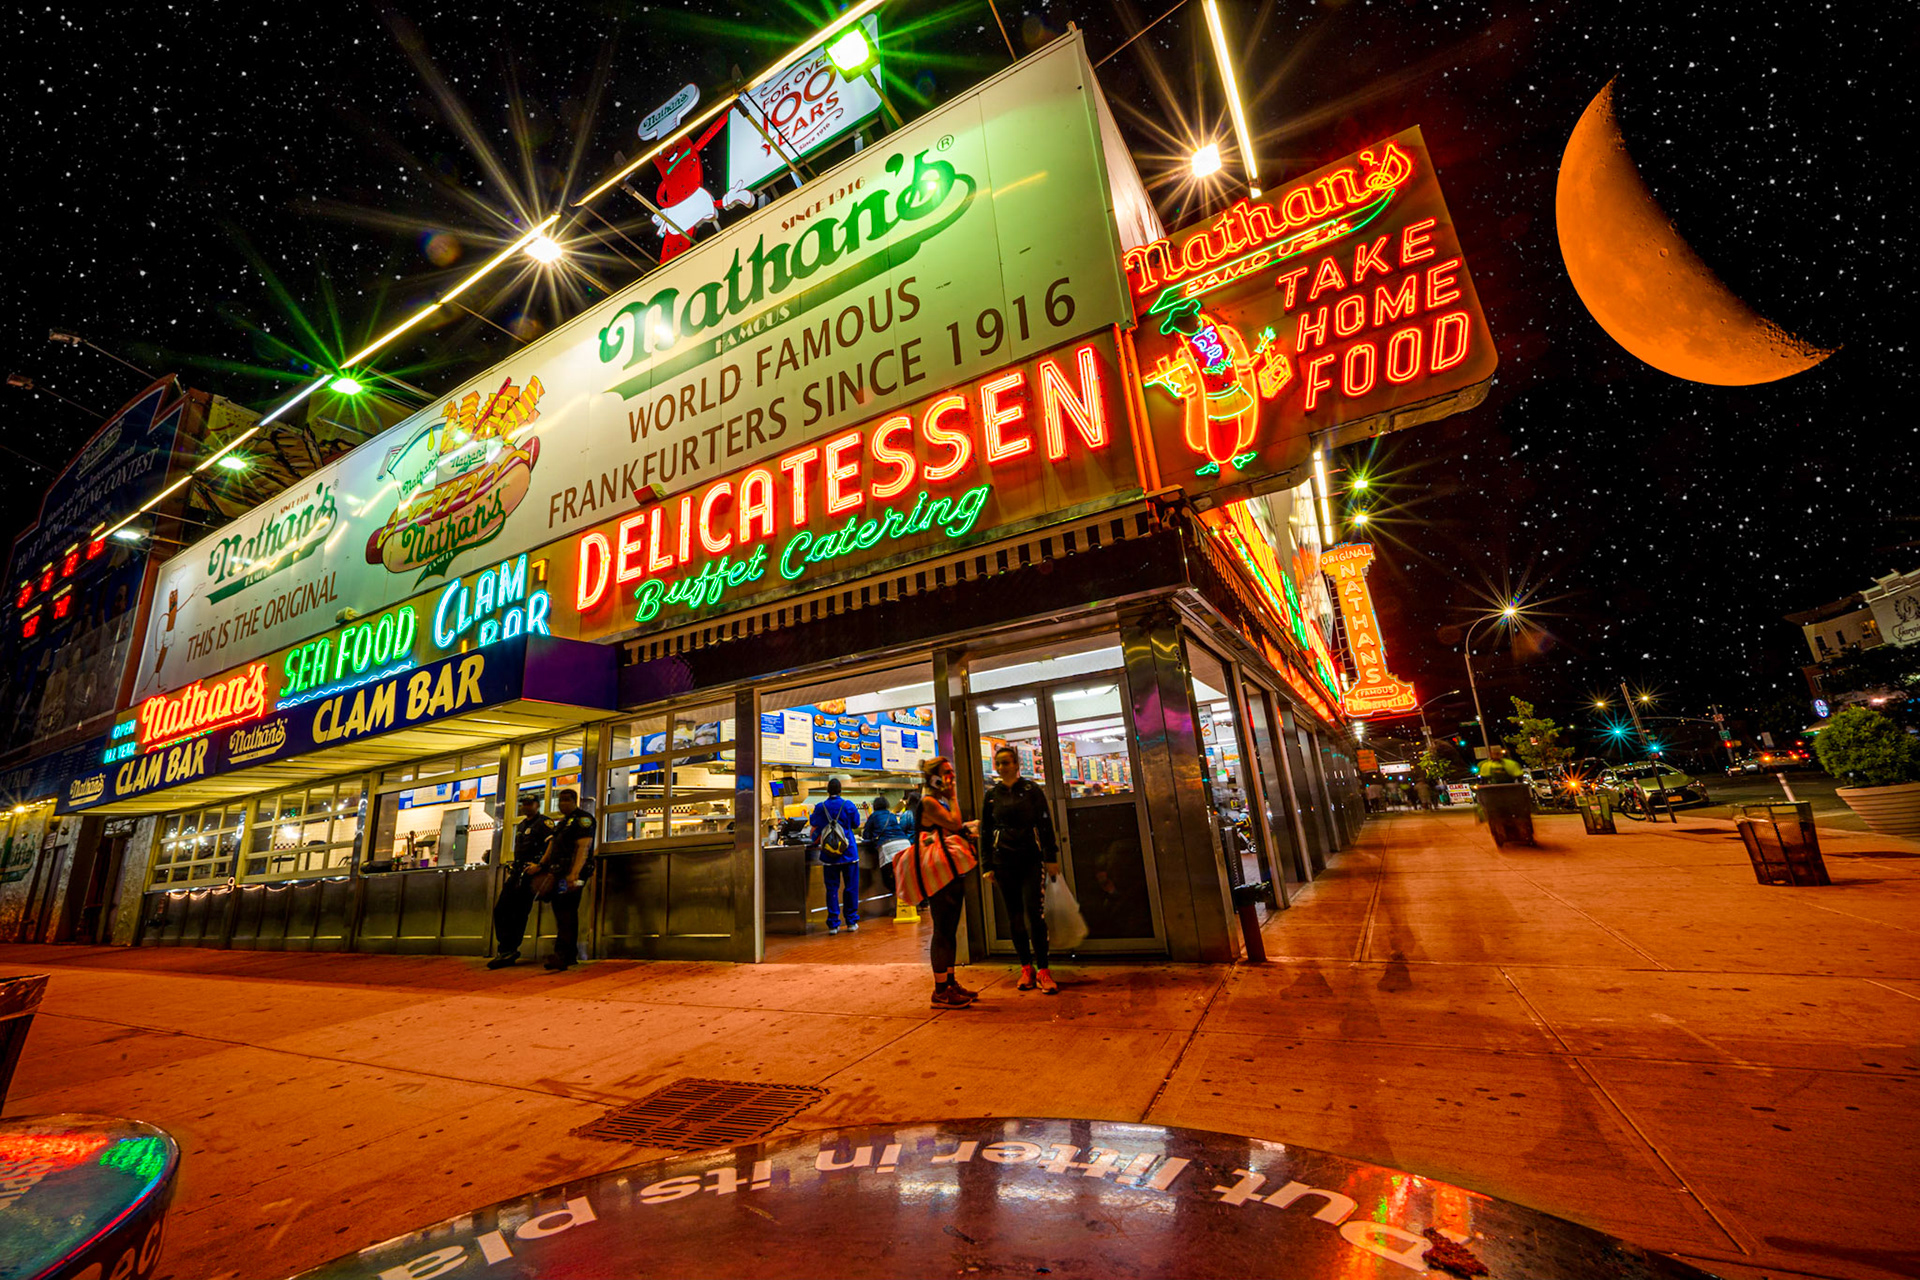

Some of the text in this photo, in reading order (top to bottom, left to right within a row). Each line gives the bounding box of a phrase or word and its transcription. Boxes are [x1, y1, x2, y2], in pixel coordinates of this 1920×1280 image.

[642, 92, 690, 129] Nathan's
[761, 90, 839, 157] YEARS
[762, 82, 791, 111] FOR
[763, 64, 837, 139] 100
[816, 122, 831, 138] 1916
[781, 175, 868, 232] SINCE 1916
[1124, 143, 1413, 294] Nathan's
[598, 148, 957, 371] Nathan's
[1186, 231, 1319, 297] FAMOUS
[1277, 217, 1437, 309] TAKE
[714, 303, 792, 355] FAMOUS
[1296, 258, 1463, 353] HOME
[628, 276, 922, 443] WORLD FAMOUS
[1304, 311, 1471, 412] FOOD
[548, 277, 1077, 529] FRANKFURTERS SINCE 1916
[103, 447, 160, 496] CONTEST
[575, 343, 1109, 613] DELICATESSEN
[207, 481, 337, 585] Nathan's
[401, 487, 503, 565] Nathan's
[633, 483, 992, 623] Buffet Catering
[1321, 546, 1371, 565] ORIGINAL
[186, 626, 217, 663] THIS
[215, 619, 231, 650] IS
[233, 605, 263, 643] THE
[263, 570, 339, 630] ORIGINAL
[433, 551, 528, 650] CLAM
[478, 589, 552, 648] BAR
[1339, 562, 1383, 685] NATHANS
[279, 604, 417, 698] SEA FOOD
[112, 719, 137, 740] OPEN
[141, 661, 269, 745] Nathan's
[311, 653, 486, 745] CLAM BAR
[1360, 686, 1395, 698] FAMOUS
[115, 751, 165, 796] CLAM
[164, 737, 210, 784] BAR
[228, 717, 287, 756] Nathan's
[639, 1159, 773, 1206] its
[814, 1143, 904, 1175] in
[930, 1140, 1193, 1192] litter
[1211, 1168, 1473, 1273] Put
